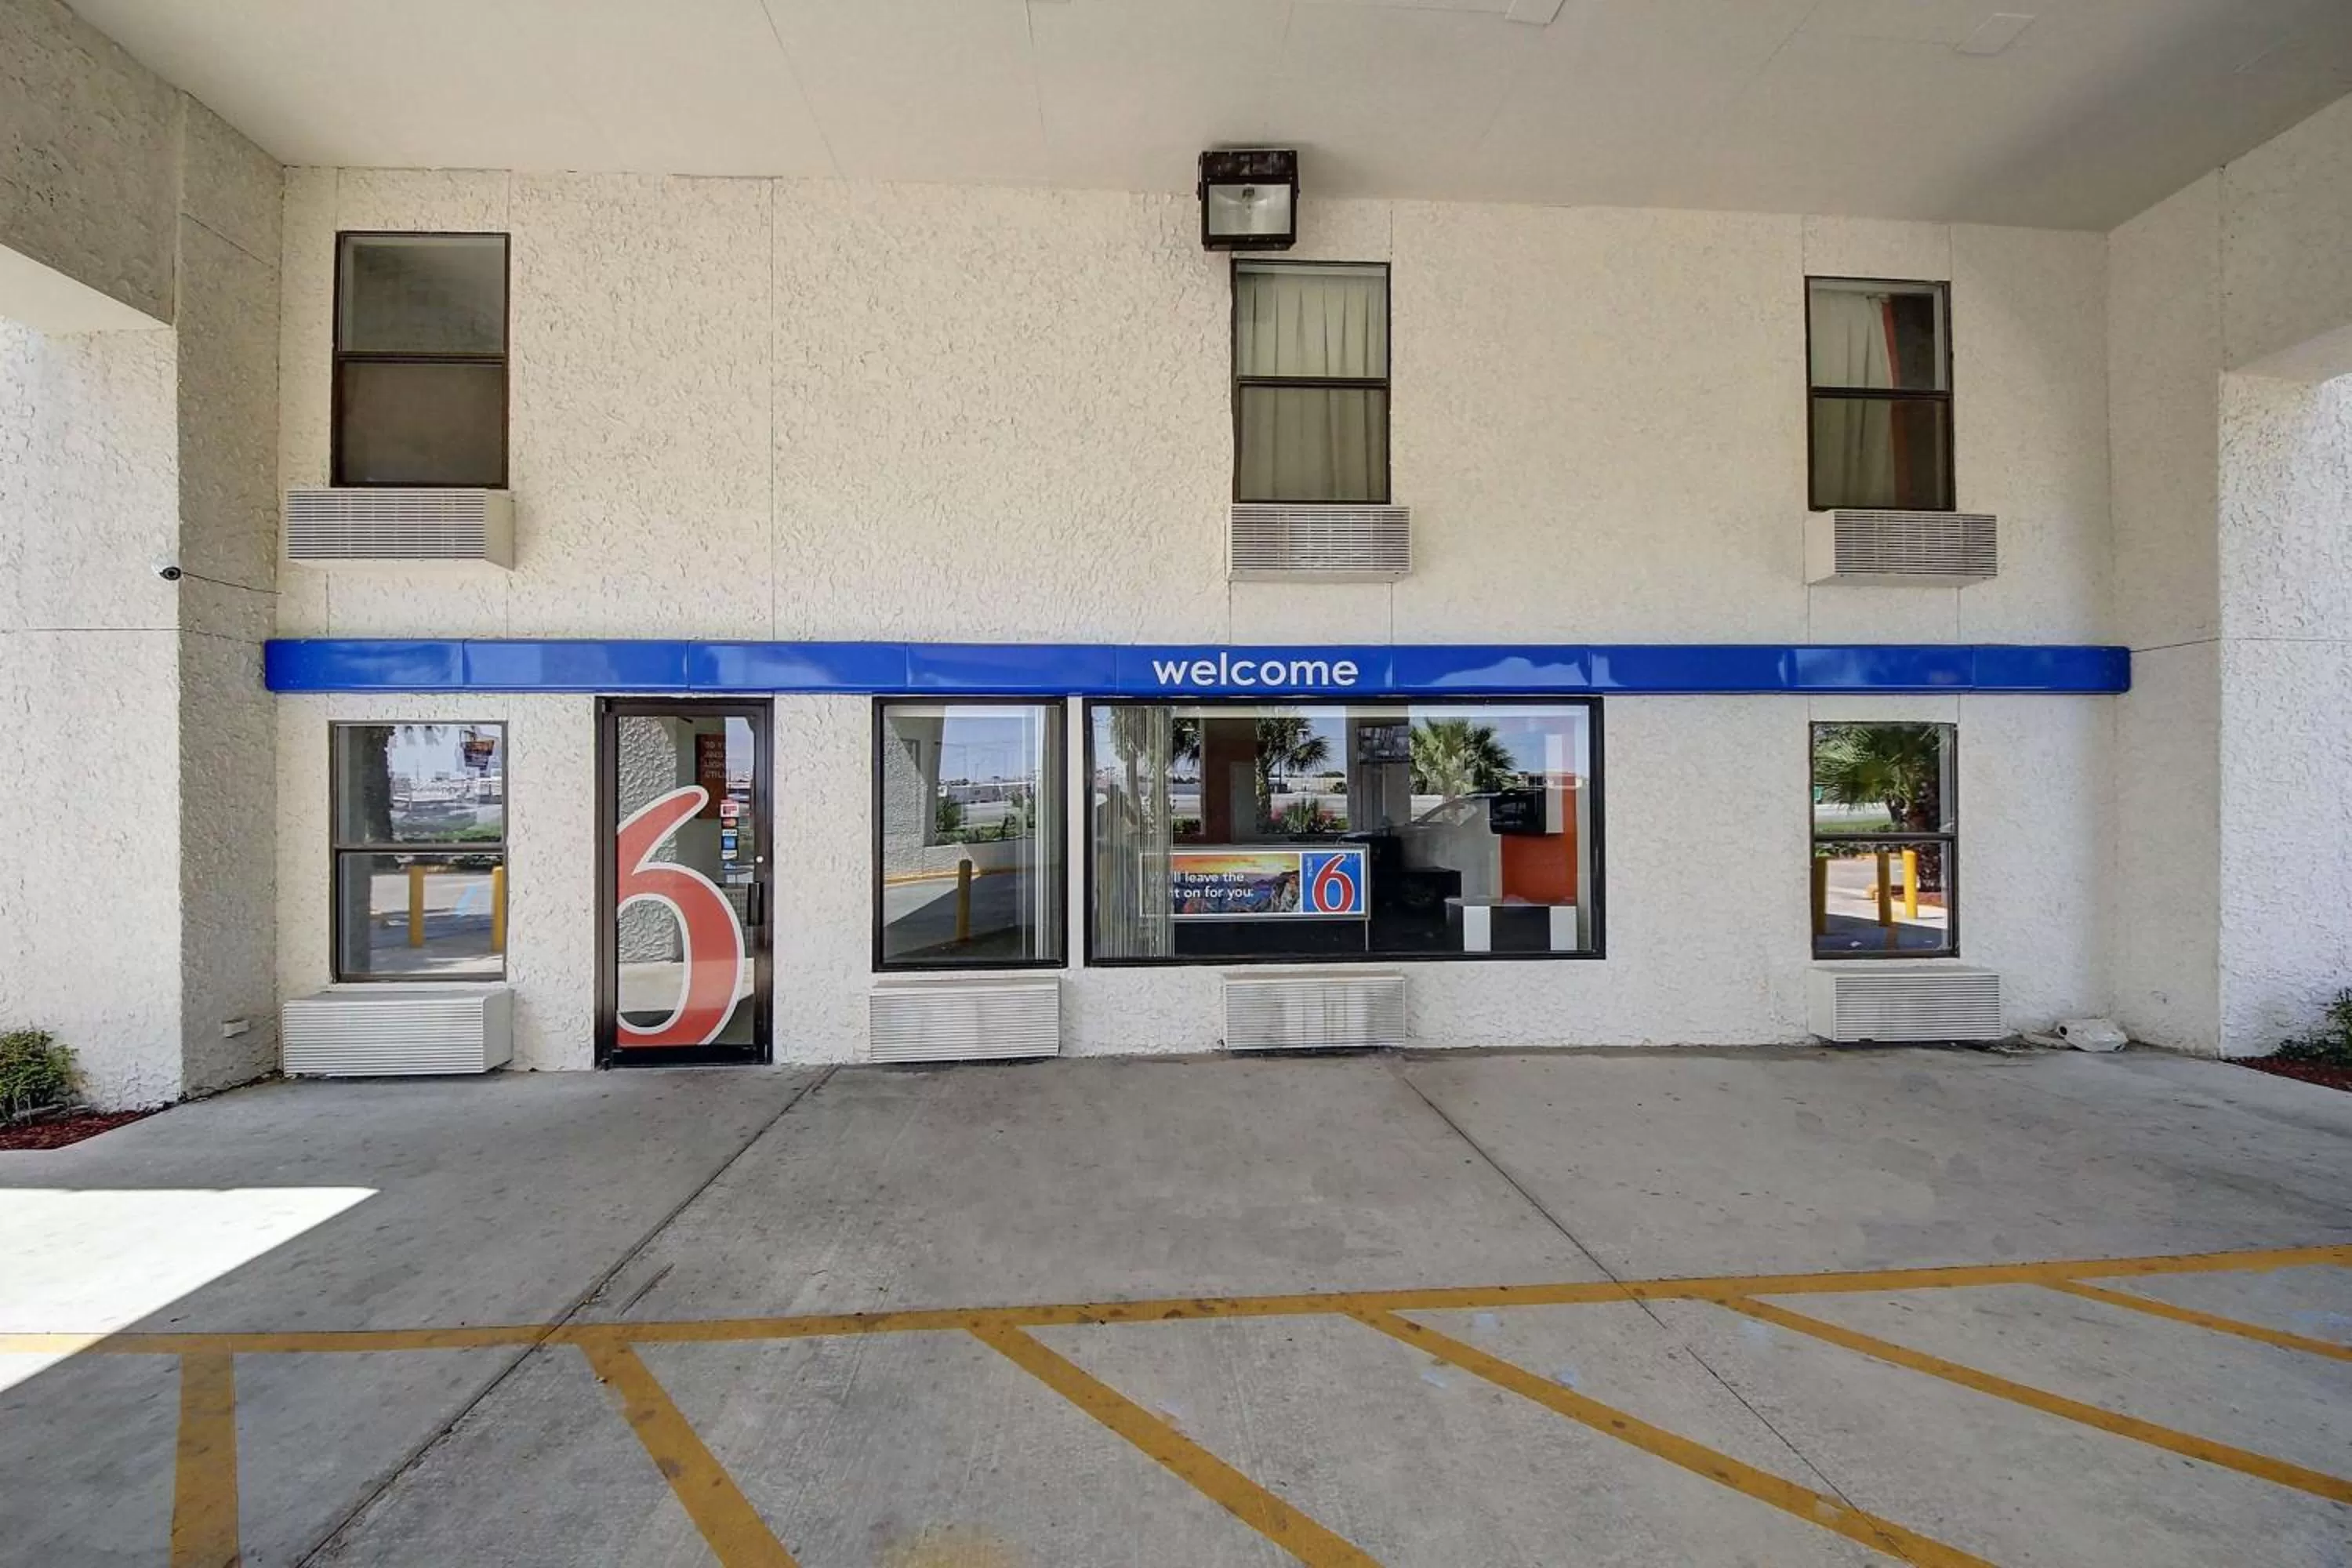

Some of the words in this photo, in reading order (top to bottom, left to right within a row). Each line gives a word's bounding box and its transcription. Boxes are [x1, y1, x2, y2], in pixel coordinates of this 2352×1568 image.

[1152, 652, 1359, 686] welcome
[1184, 888, 1200, 898] on
[1204, 885, 1224, 898] for
[1185, 871, 1218, 883] leave
[1223, 871, 1244, 882] the
[1312, 854, 1355, 913] 6
[617, 785, 745, 1045] 6
